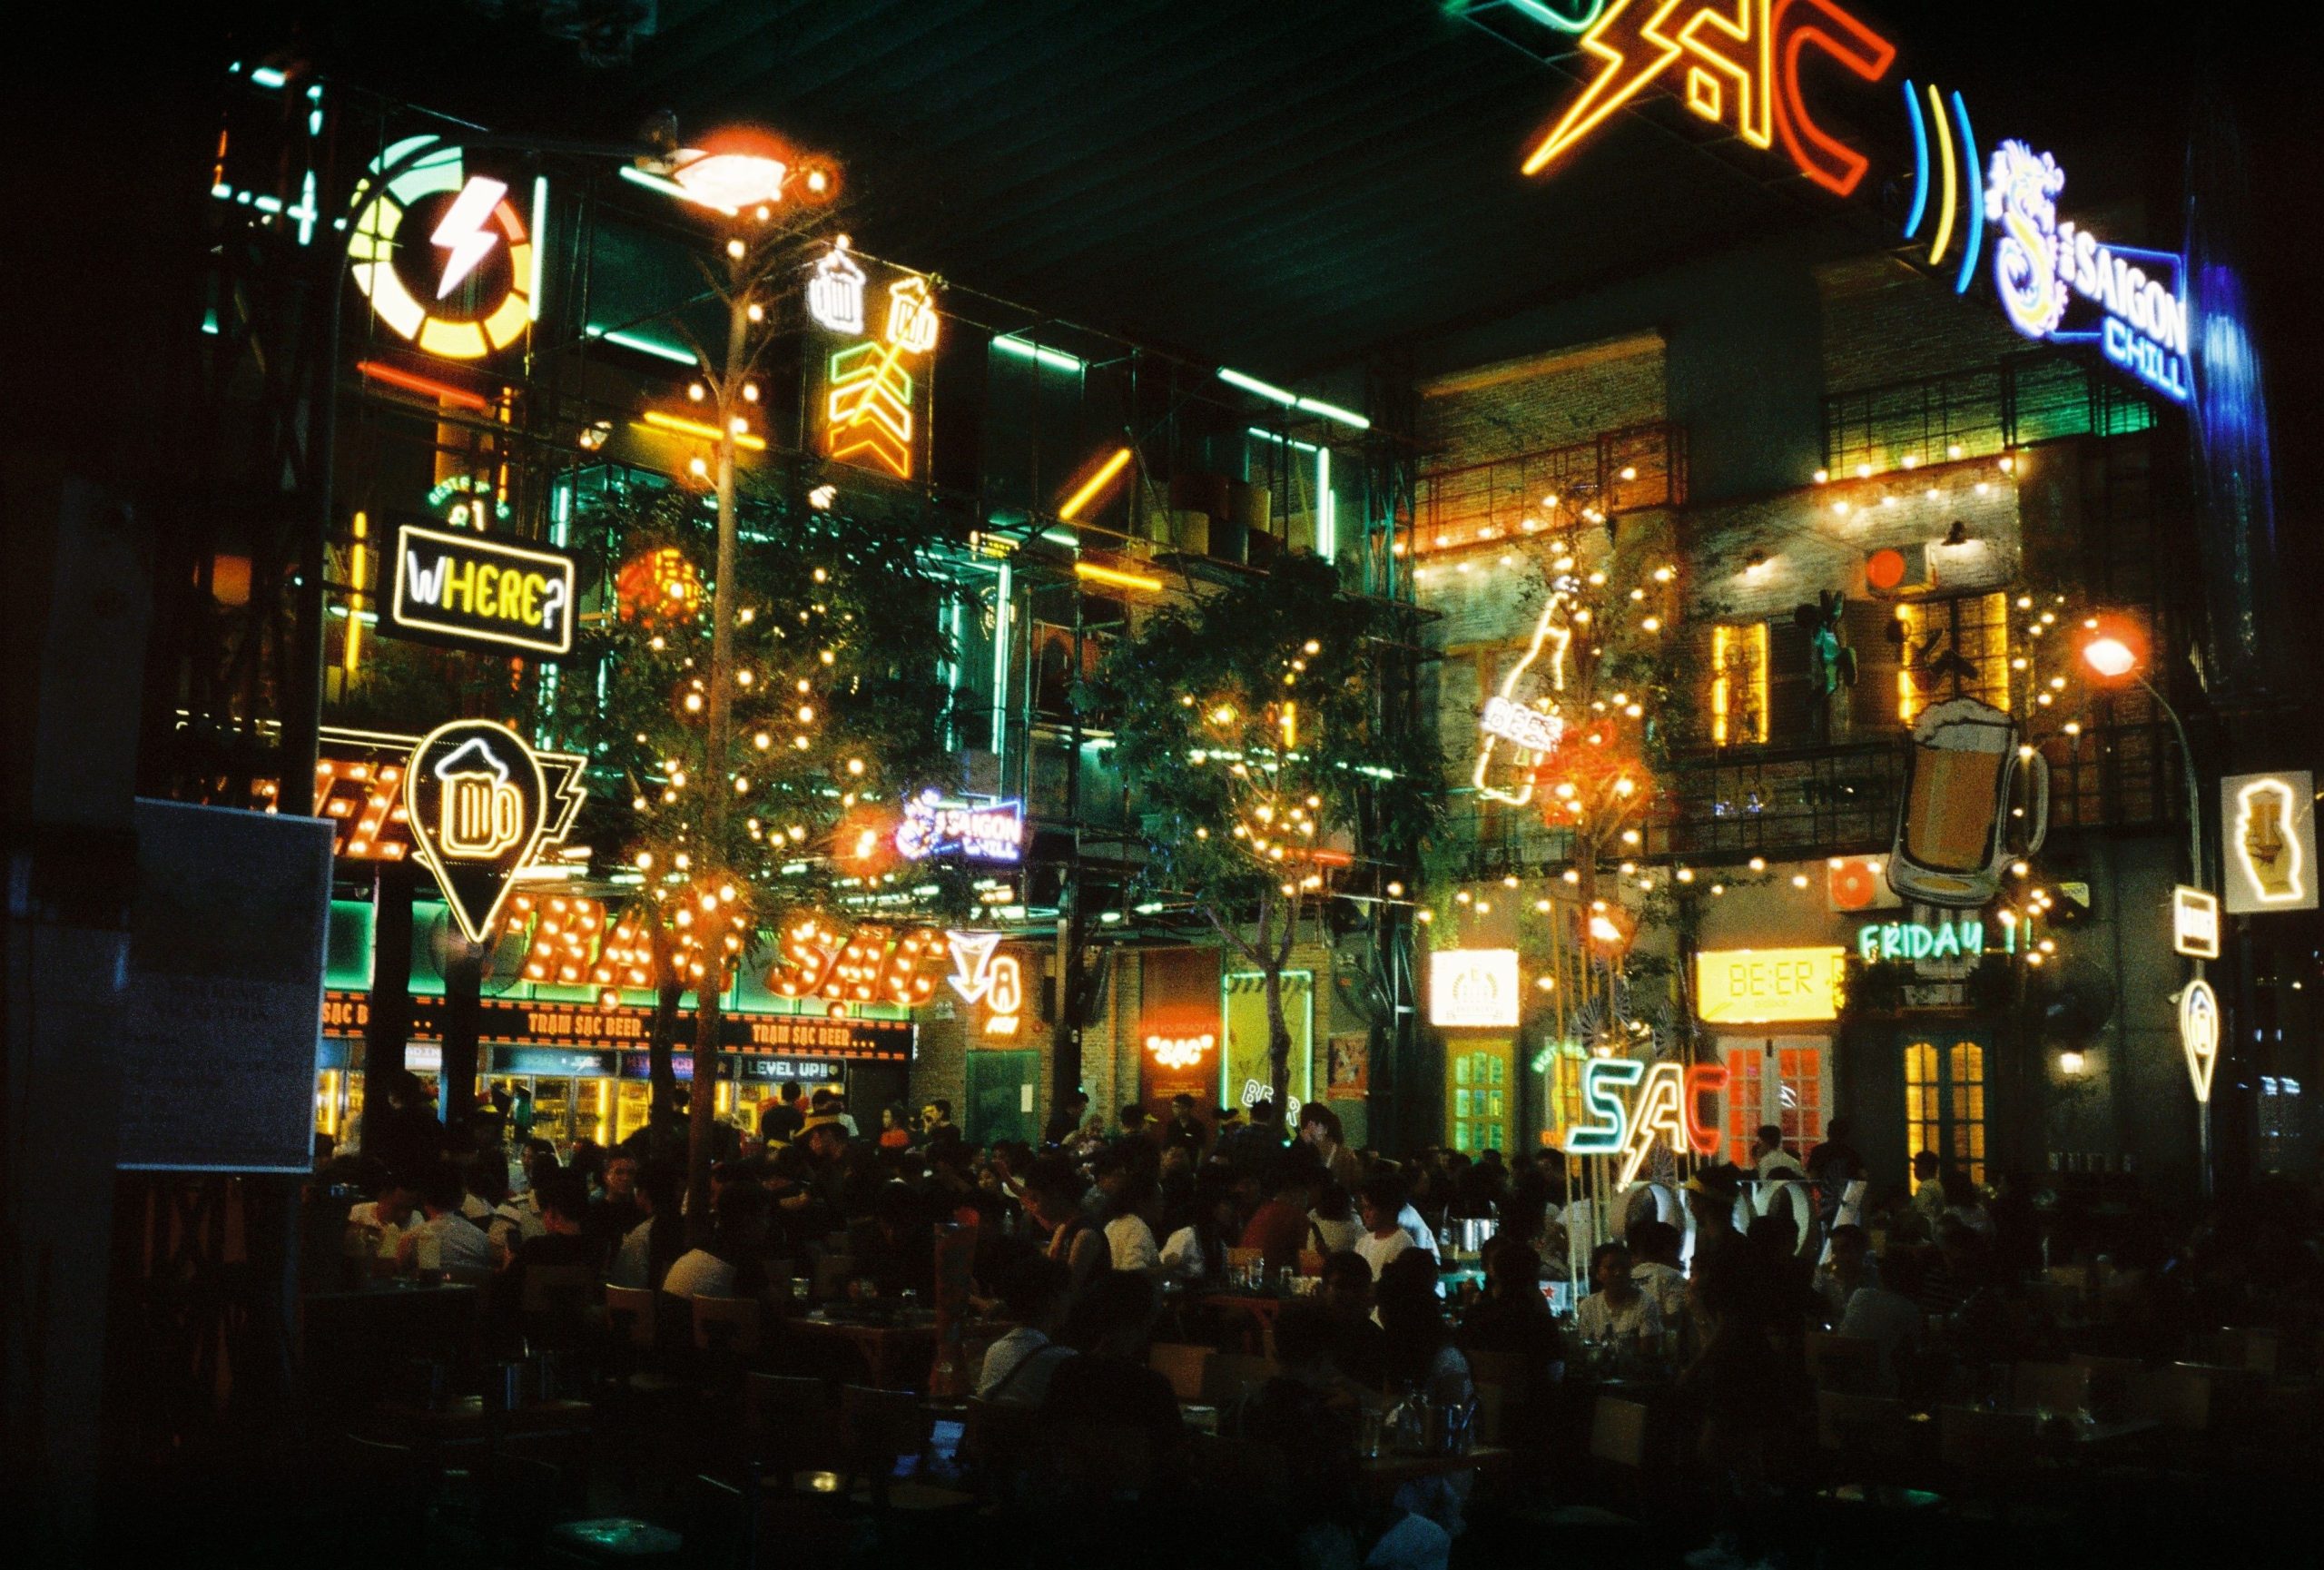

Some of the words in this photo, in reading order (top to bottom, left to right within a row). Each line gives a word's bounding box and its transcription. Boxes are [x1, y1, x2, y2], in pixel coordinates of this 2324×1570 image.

[2074, 231, 2187, 355] SAIGON
[2102, 316, 2188, 400] CHILL
[407, 550, 565, 629] WHERE?
[1860, 920, 1984, 960] FRIDAY
[748, 1060, 795, 1076] LEVEL
[1241, 1079, 1301, 1127] BER
